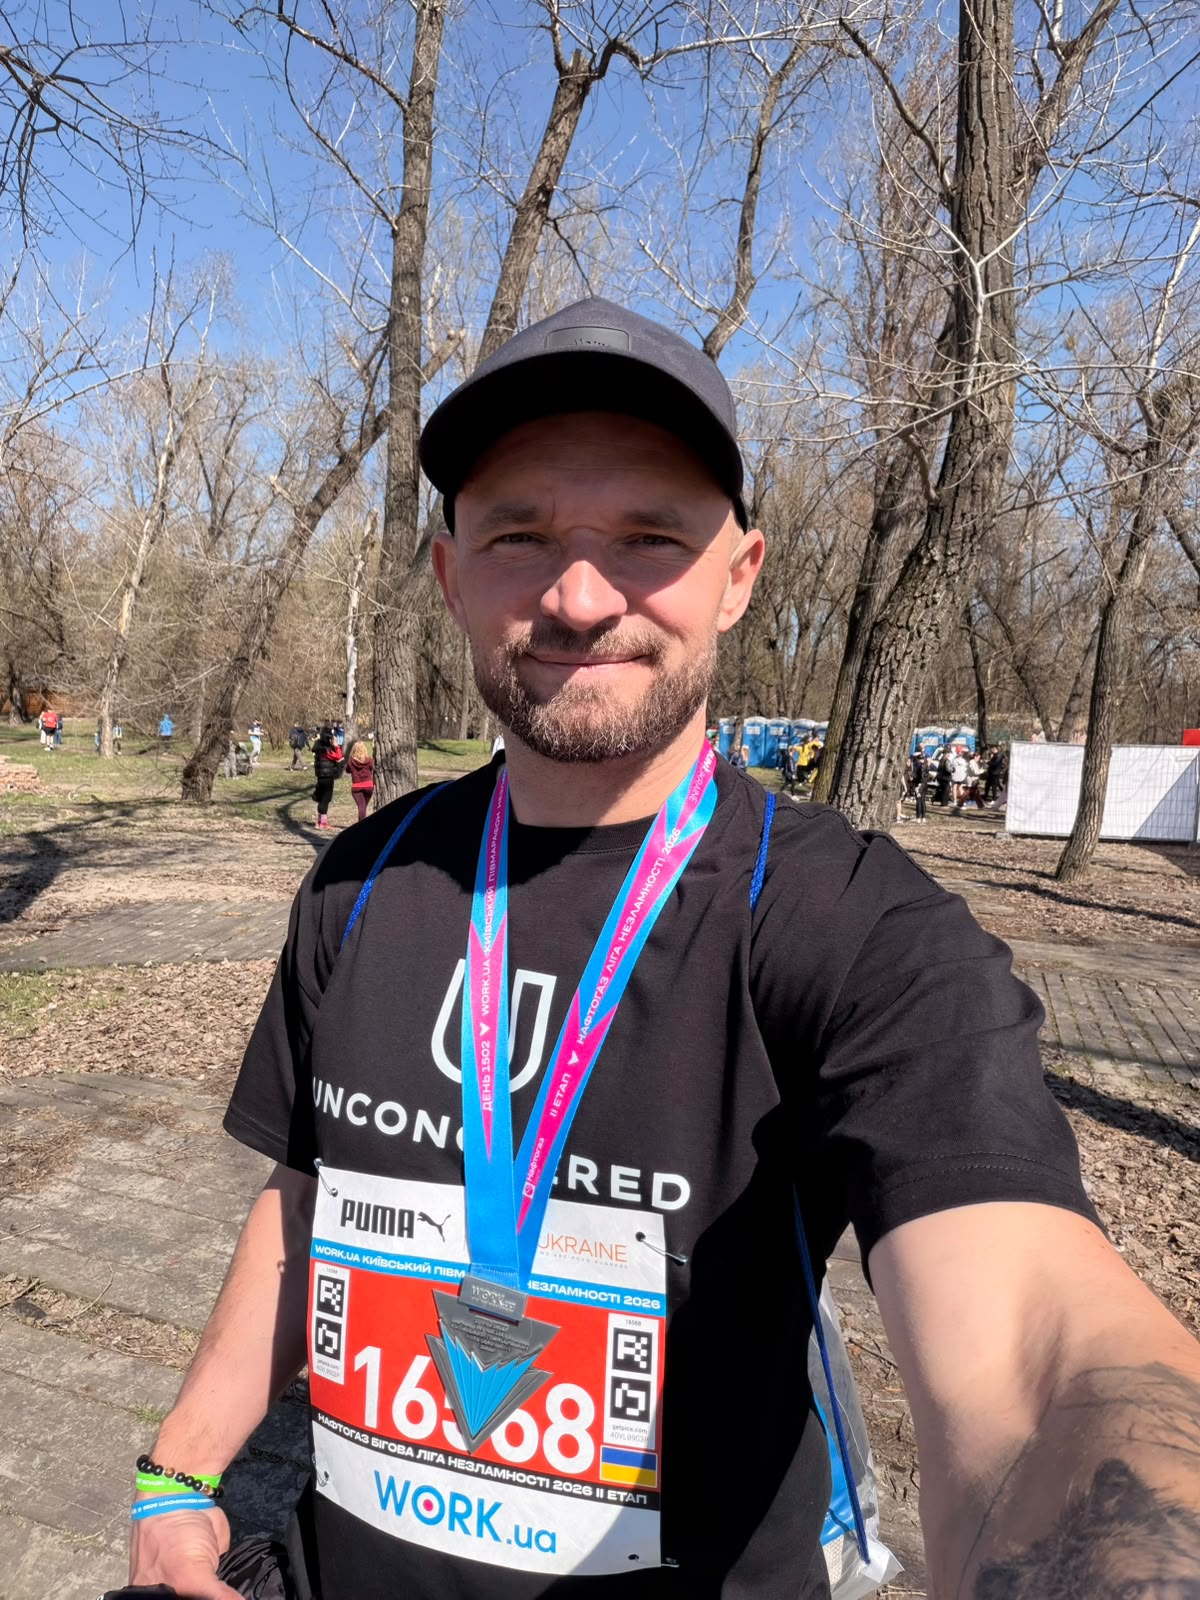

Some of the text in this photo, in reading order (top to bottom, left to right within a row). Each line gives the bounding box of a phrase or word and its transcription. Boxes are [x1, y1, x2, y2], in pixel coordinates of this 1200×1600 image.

[484, 887, 496, 951] КИЇВСЬКИЙ
[481, 959, 492, 1016] WORK.UA
[553, 1072, 571, 1108] ЕТАП
[576, 976, 609, 1045] НАФТОГАЗ
[606, 945, 623, 973] ЛІГА
[618, 856, 666, 942] НЕЗЛАМНОСТІ
[661, 827, 681, 856] 2026
[481, 1040, 491, 1073] 1502
[482, 1075, 493, 1112] ДЕНЬ
[312, 1076, 692, 1213] UNCONRED
[526, 1137, 545, 1181] Нафтогаз
[340, 1198, 415, 1239] PUMA
[538, 1233, 628, 1263] UKRAINE
[315, 1244, 360, 1261] WORK.UA
[362, 1255, 431, 1274] КИЇВСЬКИЙ
[623, 1295, 661, 1310] 2026
[318, 1412, 369, 1444] НАФТОГАЗ
[371, 1437, 415, 1458] БІГОВА
[416, 1449, 446, 1465] ЛІГА
[448, 1455, 550, 1489] НЕЗЛАМНОСТІ
[552, 1480, 593, 1497] 2026
[607, 1491, 647, 1505] ЕТАП
[373, 1469, 557, 1554] WORK.ua
